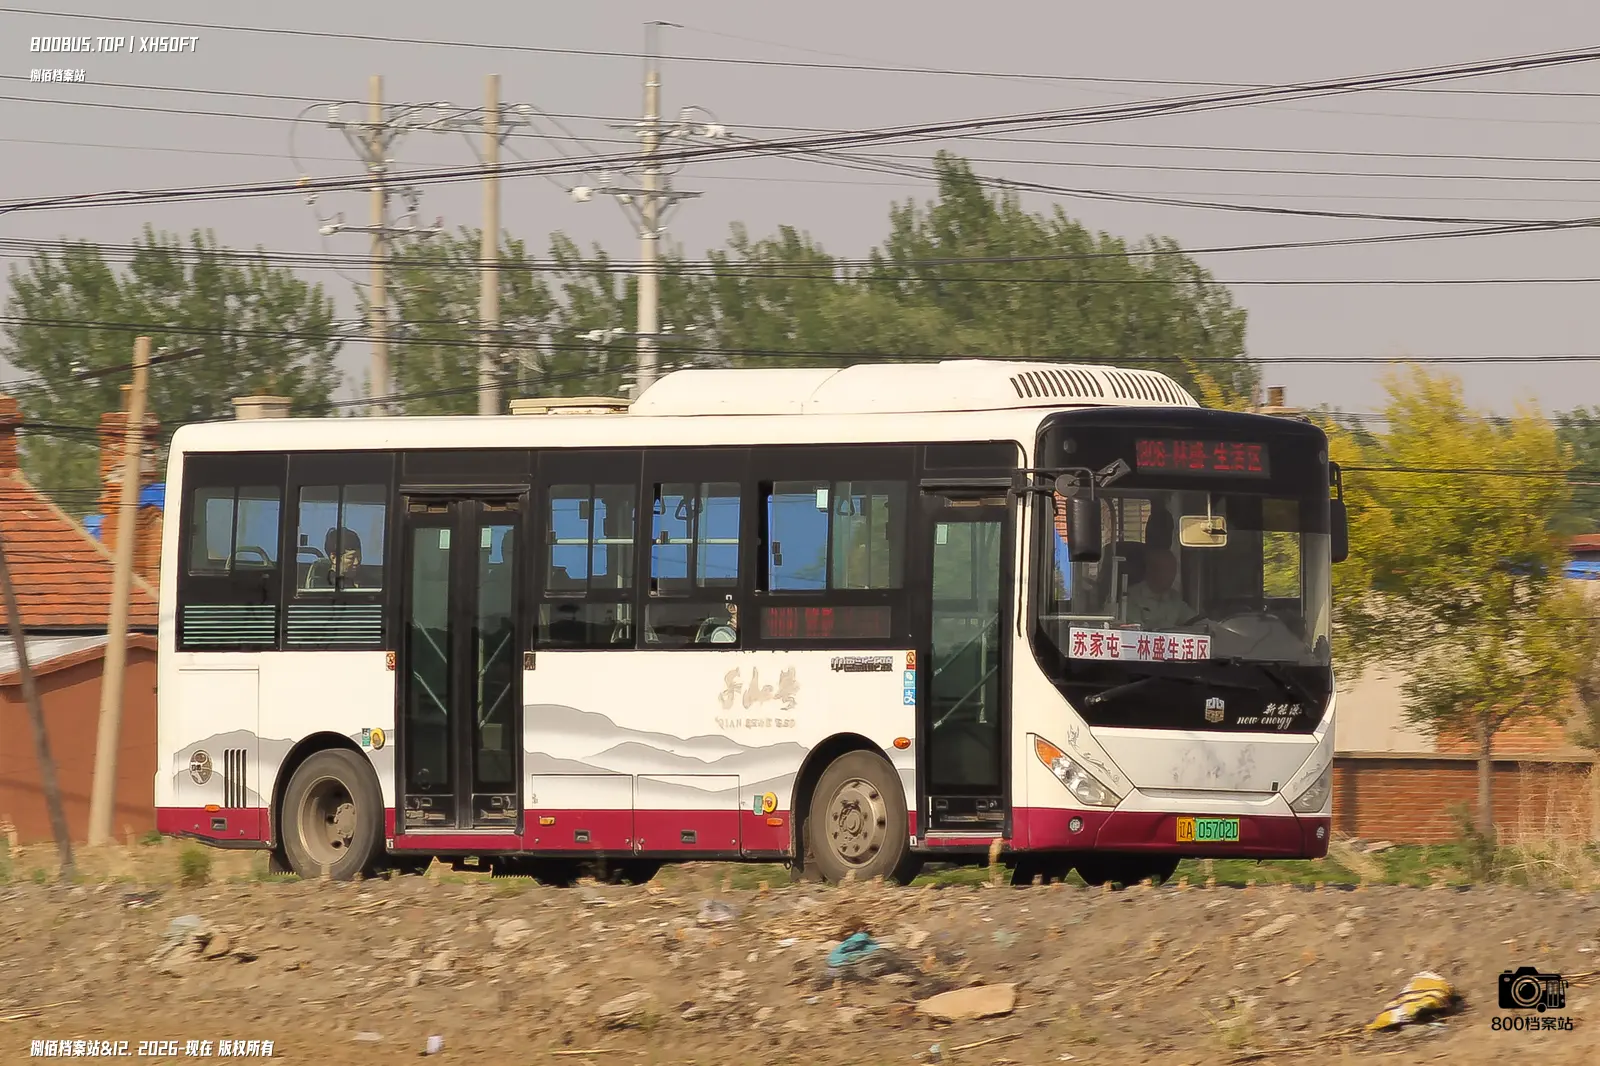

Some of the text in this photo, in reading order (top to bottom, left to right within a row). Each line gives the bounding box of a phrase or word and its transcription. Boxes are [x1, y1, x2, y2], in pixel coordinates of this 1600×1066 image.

[1263, 702, 1303, 716] 新能源
[1198, 821, 1238, 838] 05702D
